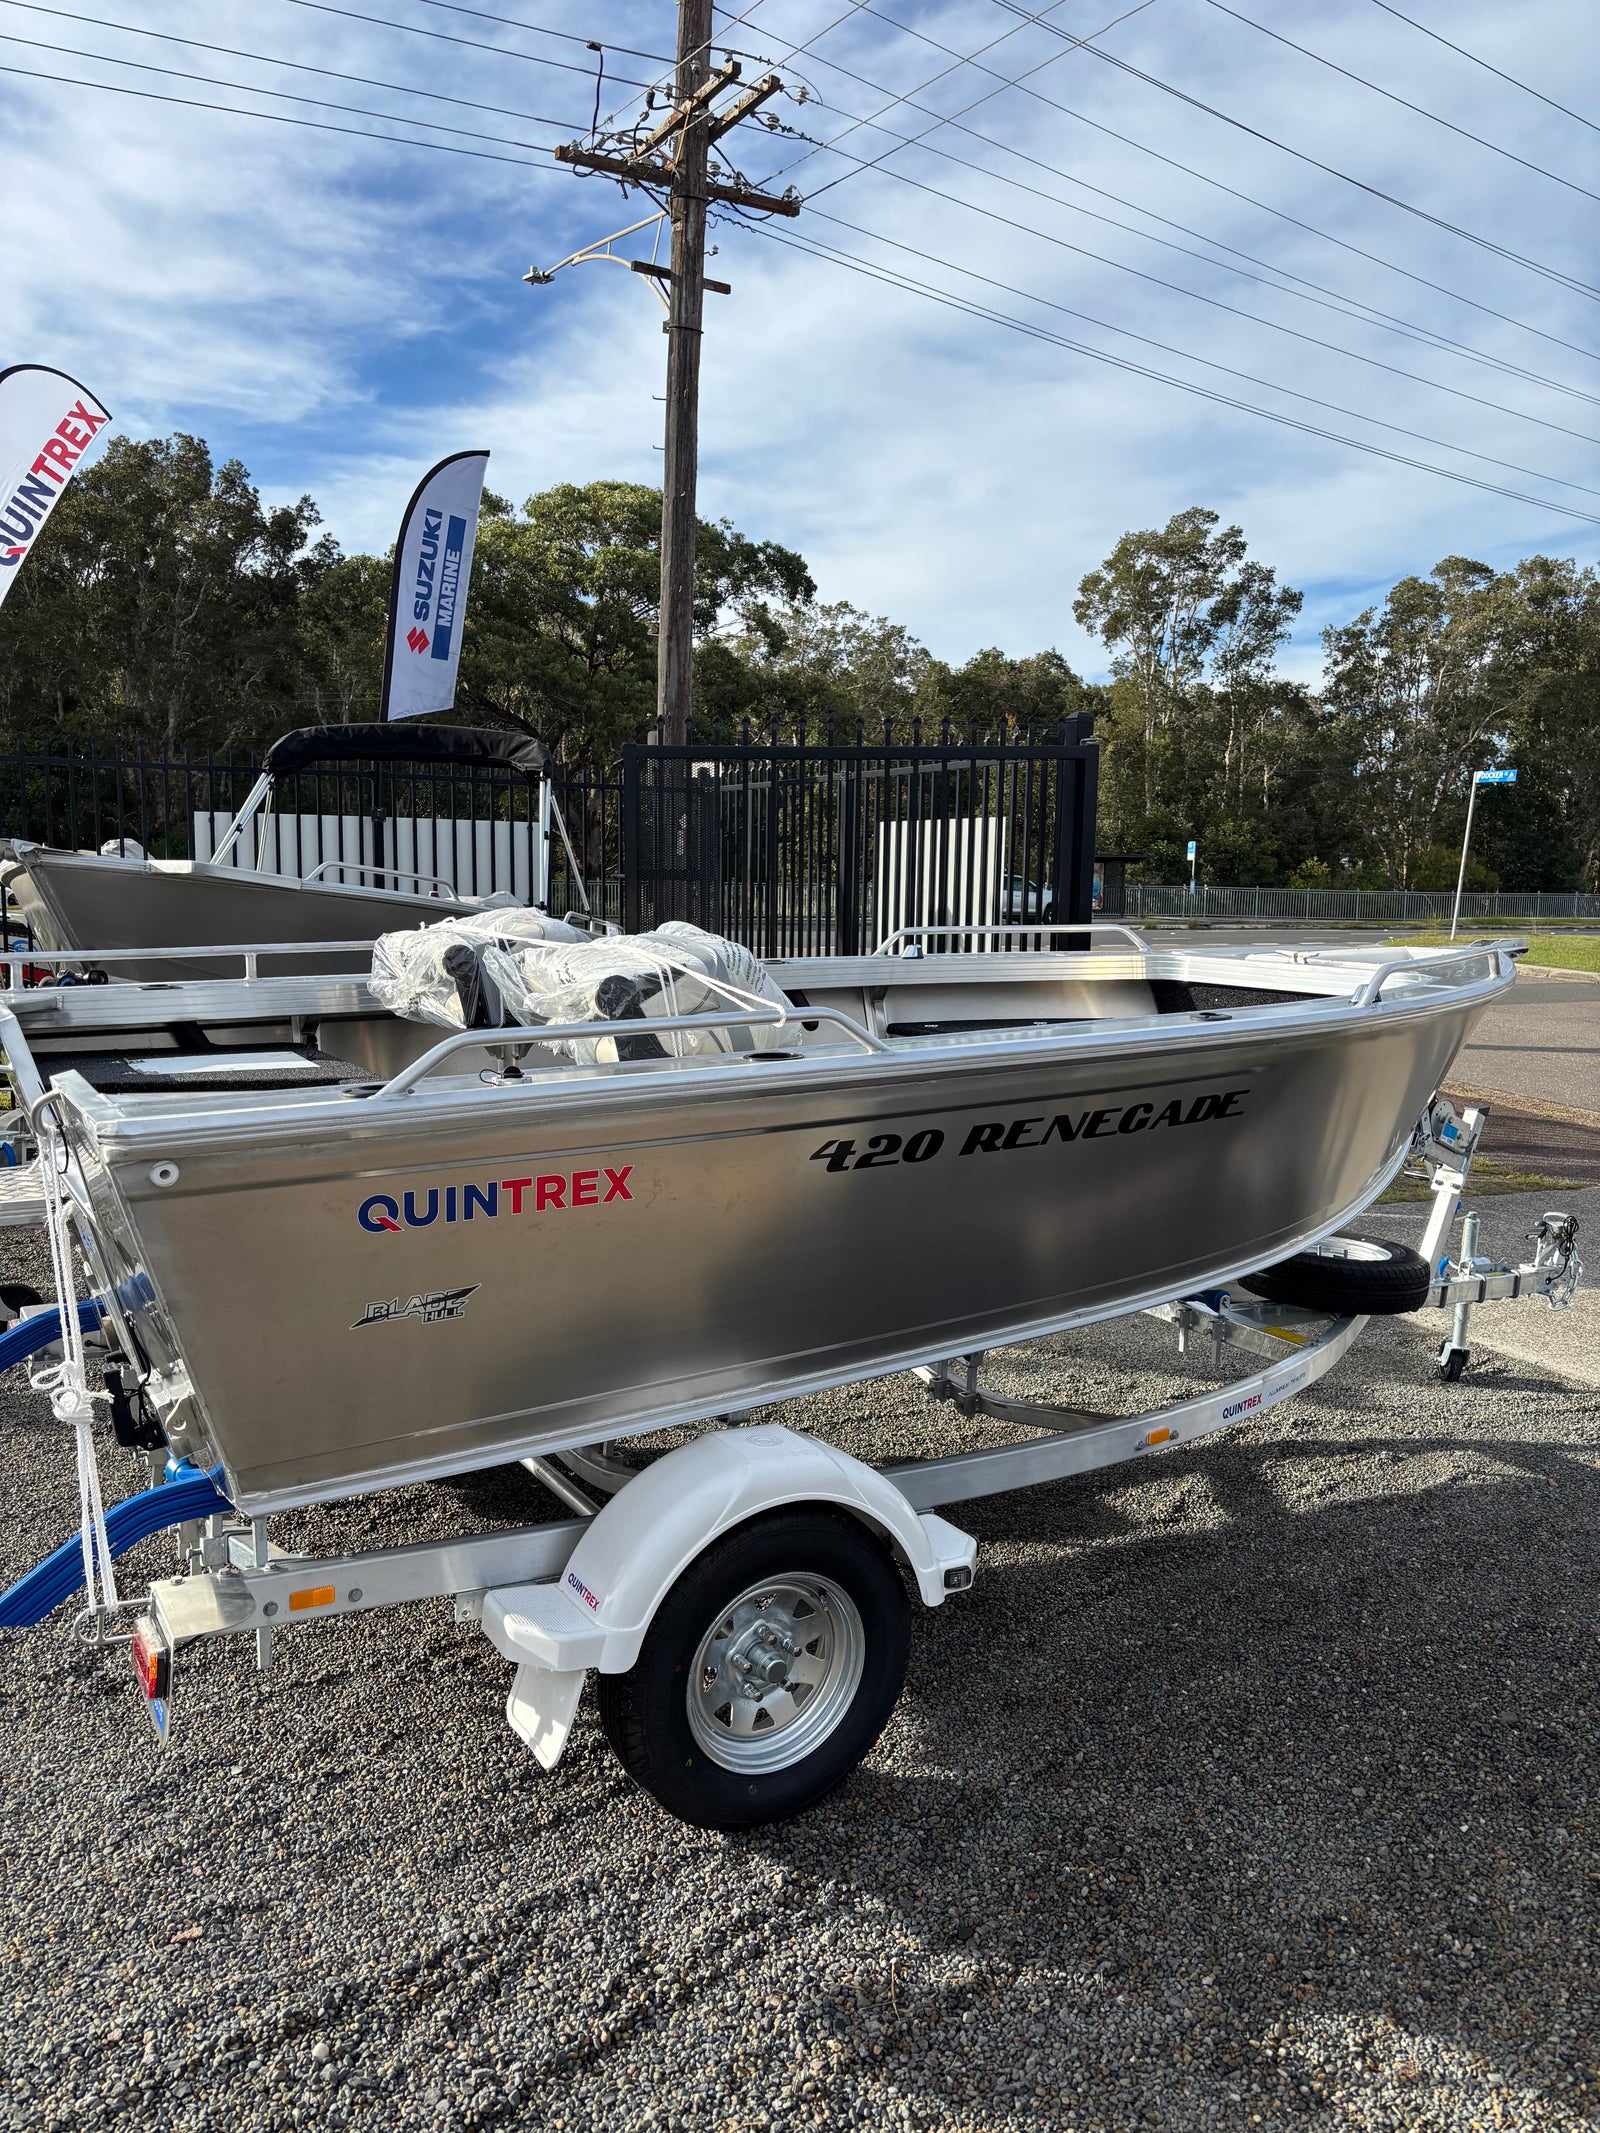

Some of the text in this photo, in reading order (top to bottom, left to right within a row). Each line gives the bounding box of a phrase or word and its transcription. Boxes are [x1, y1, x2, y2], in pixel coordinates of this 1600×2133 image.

[0, 399, 107, 567] QUINTREX
[413, 508, 443, 622] SUZUKI
[437, 548, 461, 627] MARINE
[808, 1089, 1251, 1173] 420 RENEGADE
[357, 1165, 635, 1233] QUINTREX
[358, 1286, 477, 1326] BLADE
[422, 1308, 465, 1324] HULL
[1222, 1393, 1262, 1420] QUINTREX
[567, 1572, 600, 1612] QUINTREX
